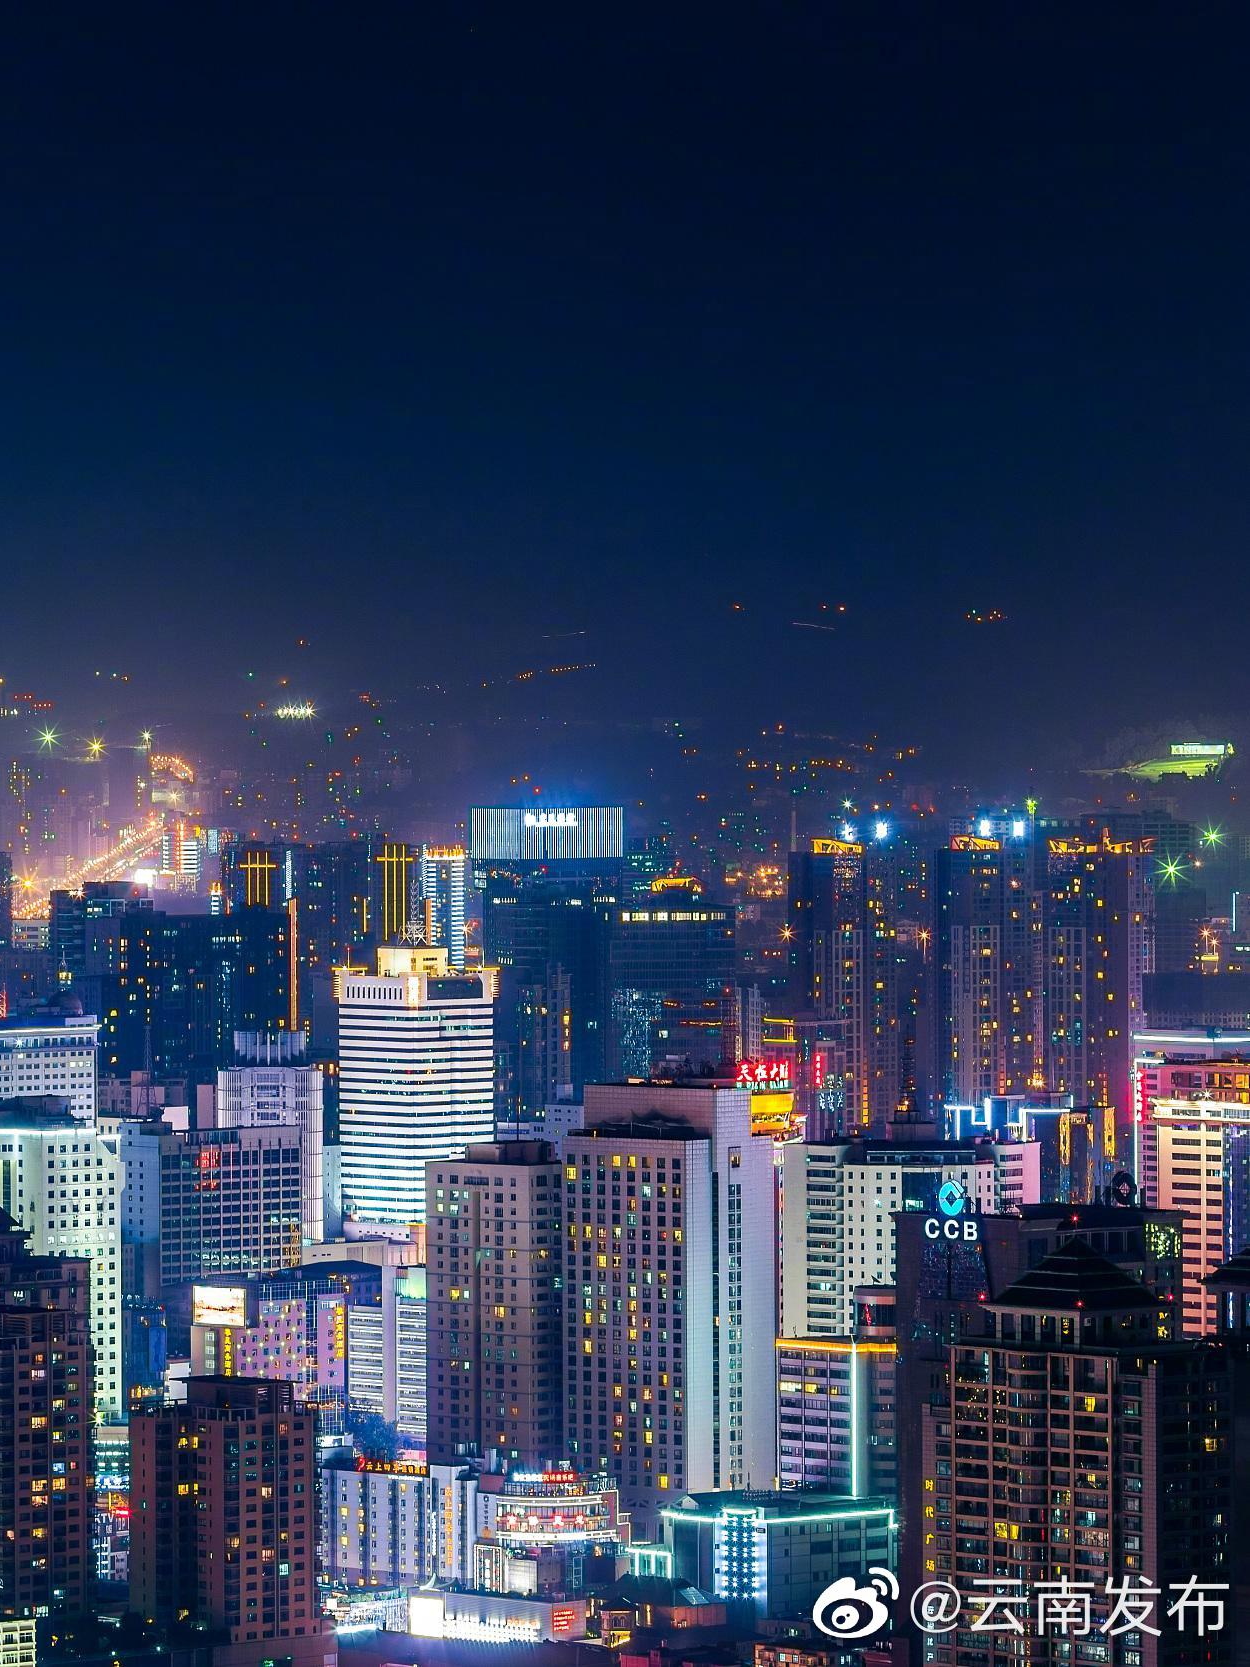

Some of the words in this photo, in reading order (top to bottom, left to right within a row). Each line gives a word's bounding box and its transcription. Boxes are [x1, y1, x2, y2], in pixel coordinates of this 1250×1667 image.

[924, 1217, 979, 1241] CCB
[925, 1479, 935, 1572] 时代广场
